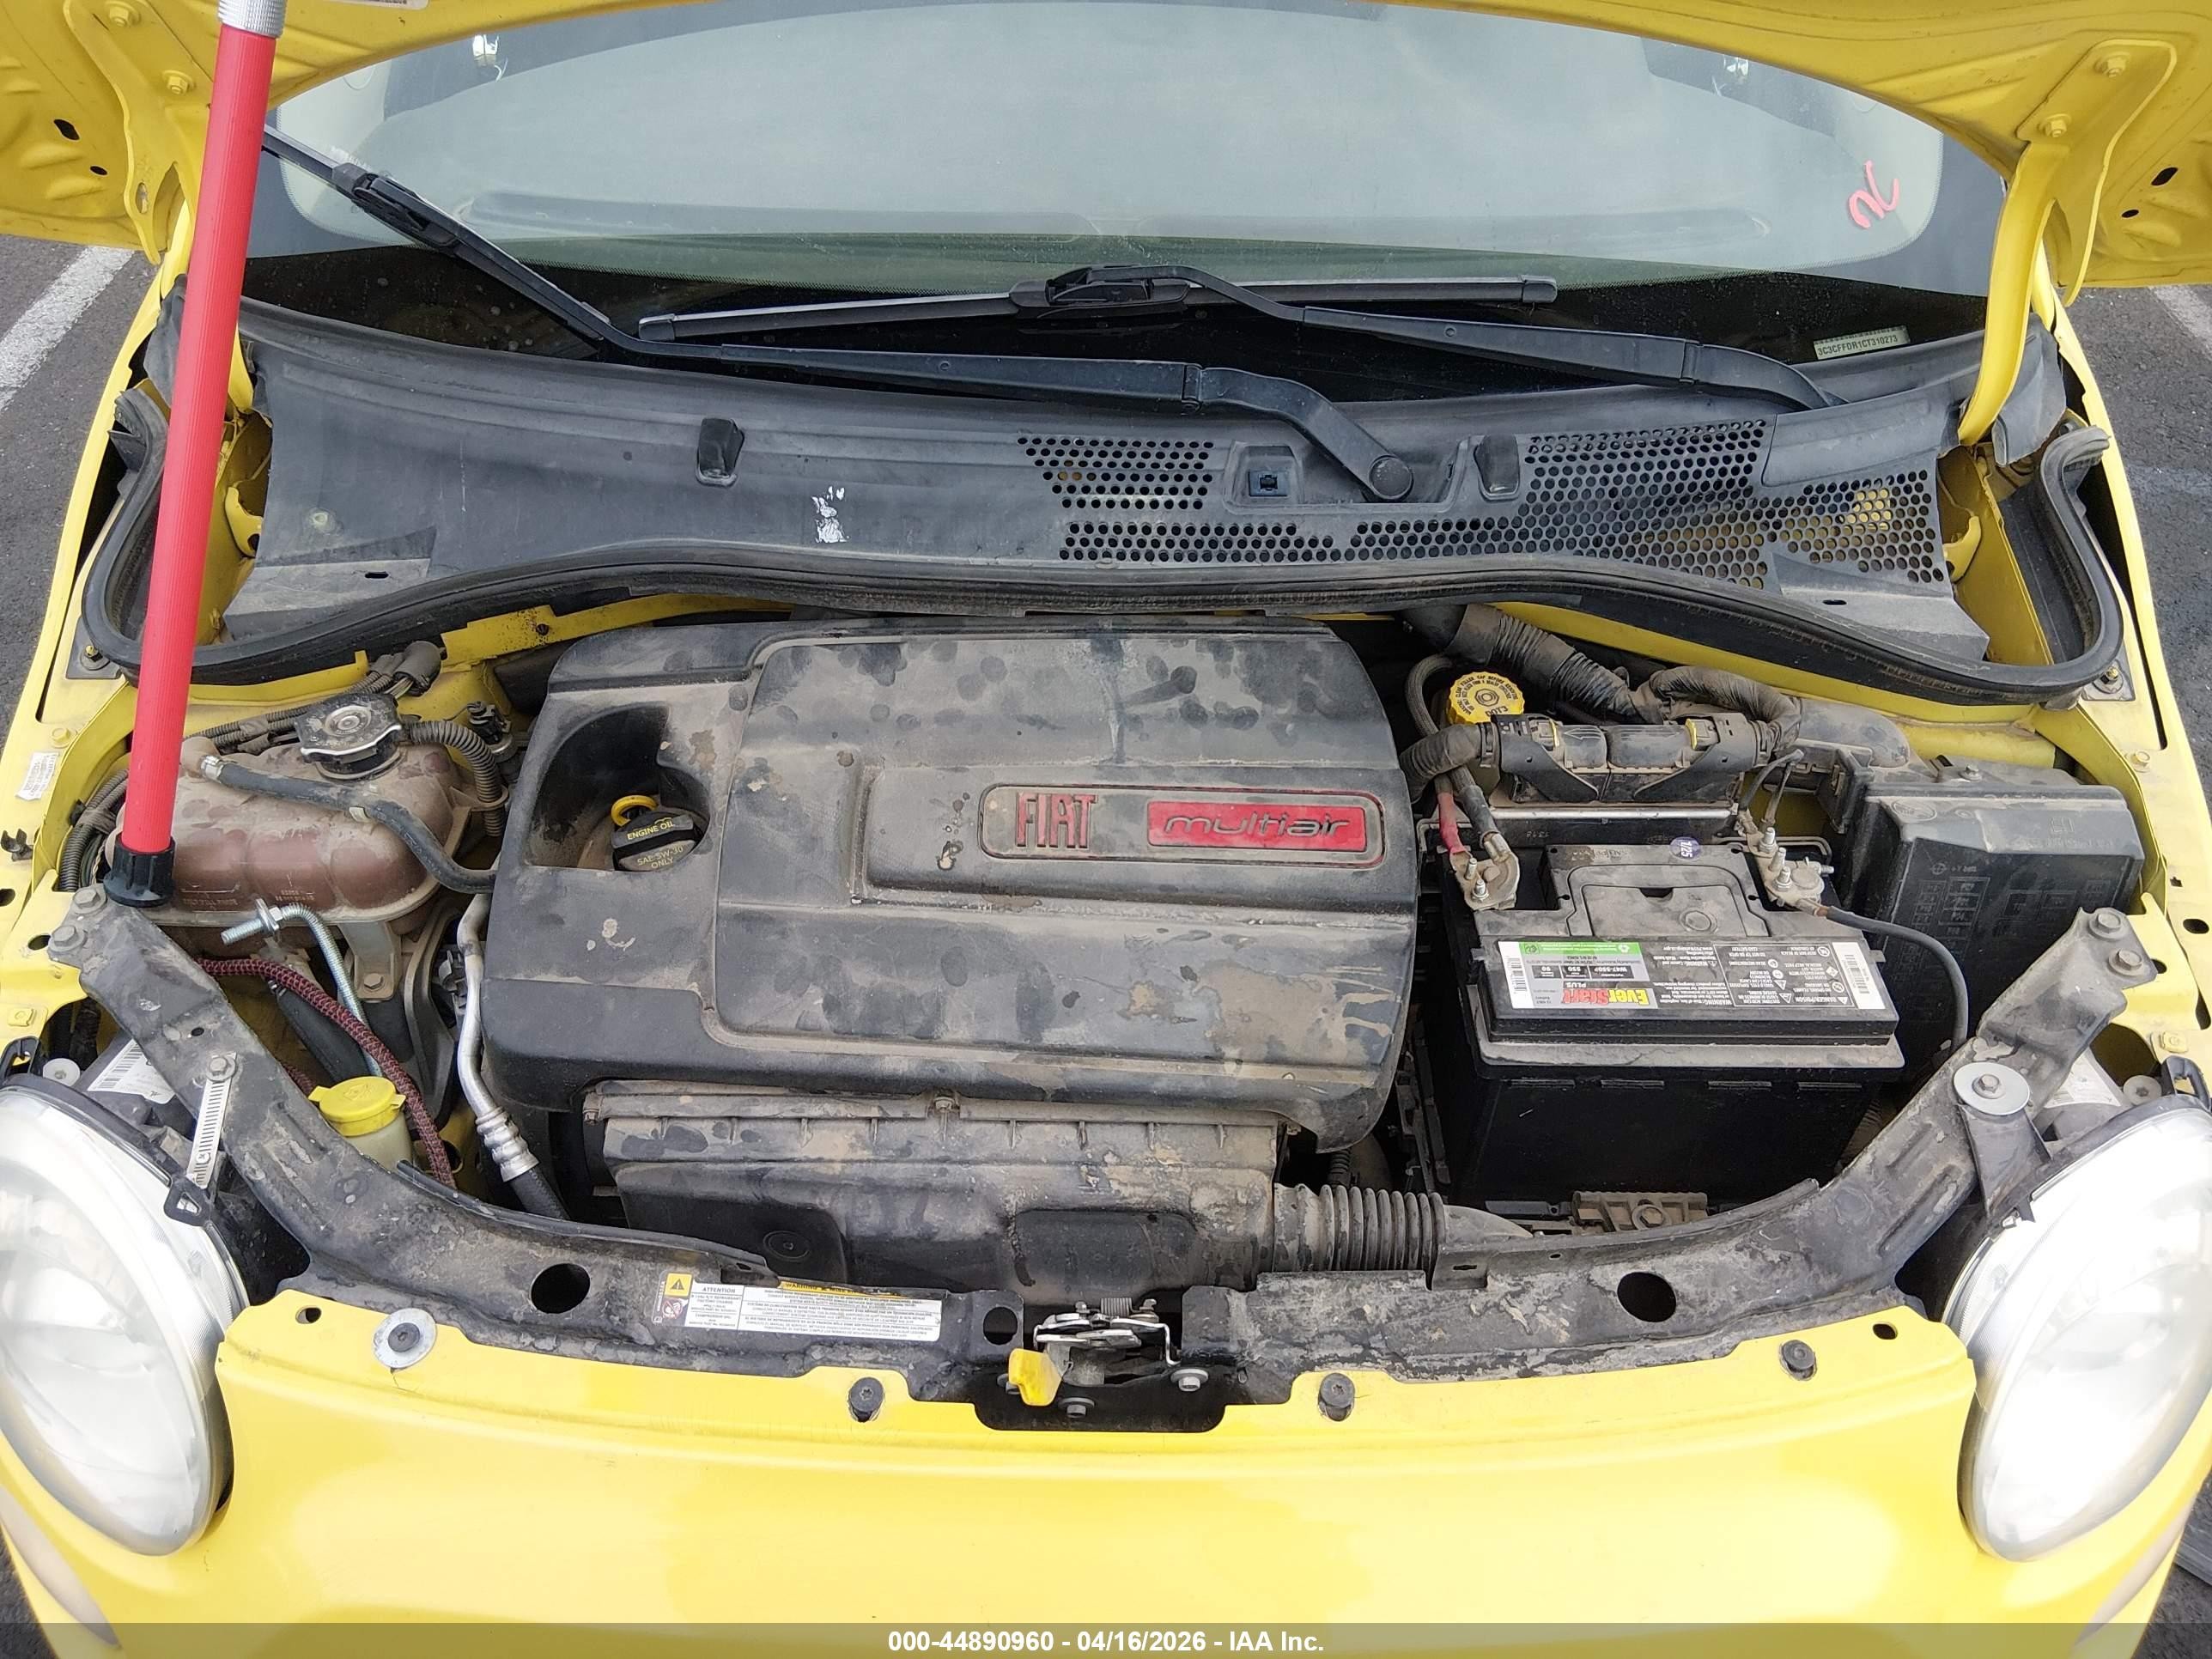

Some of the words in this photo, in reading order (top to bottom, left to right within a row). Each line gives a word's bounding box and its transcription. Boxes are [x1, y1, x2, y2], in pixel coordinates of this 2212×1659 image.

[1817, 335, 1898, 356] 3C3CFFDR1CT310273
[627, 825, 659, 840] ENGINE
[660, 820, 675, 829] OIL
[1017, 793, 1098, 849] FIAT
[1164, 811, 1352, 838] multiair
[651, 857, 674, 869] ONLY
[1561, 988, 1650, 1006] EverStart
